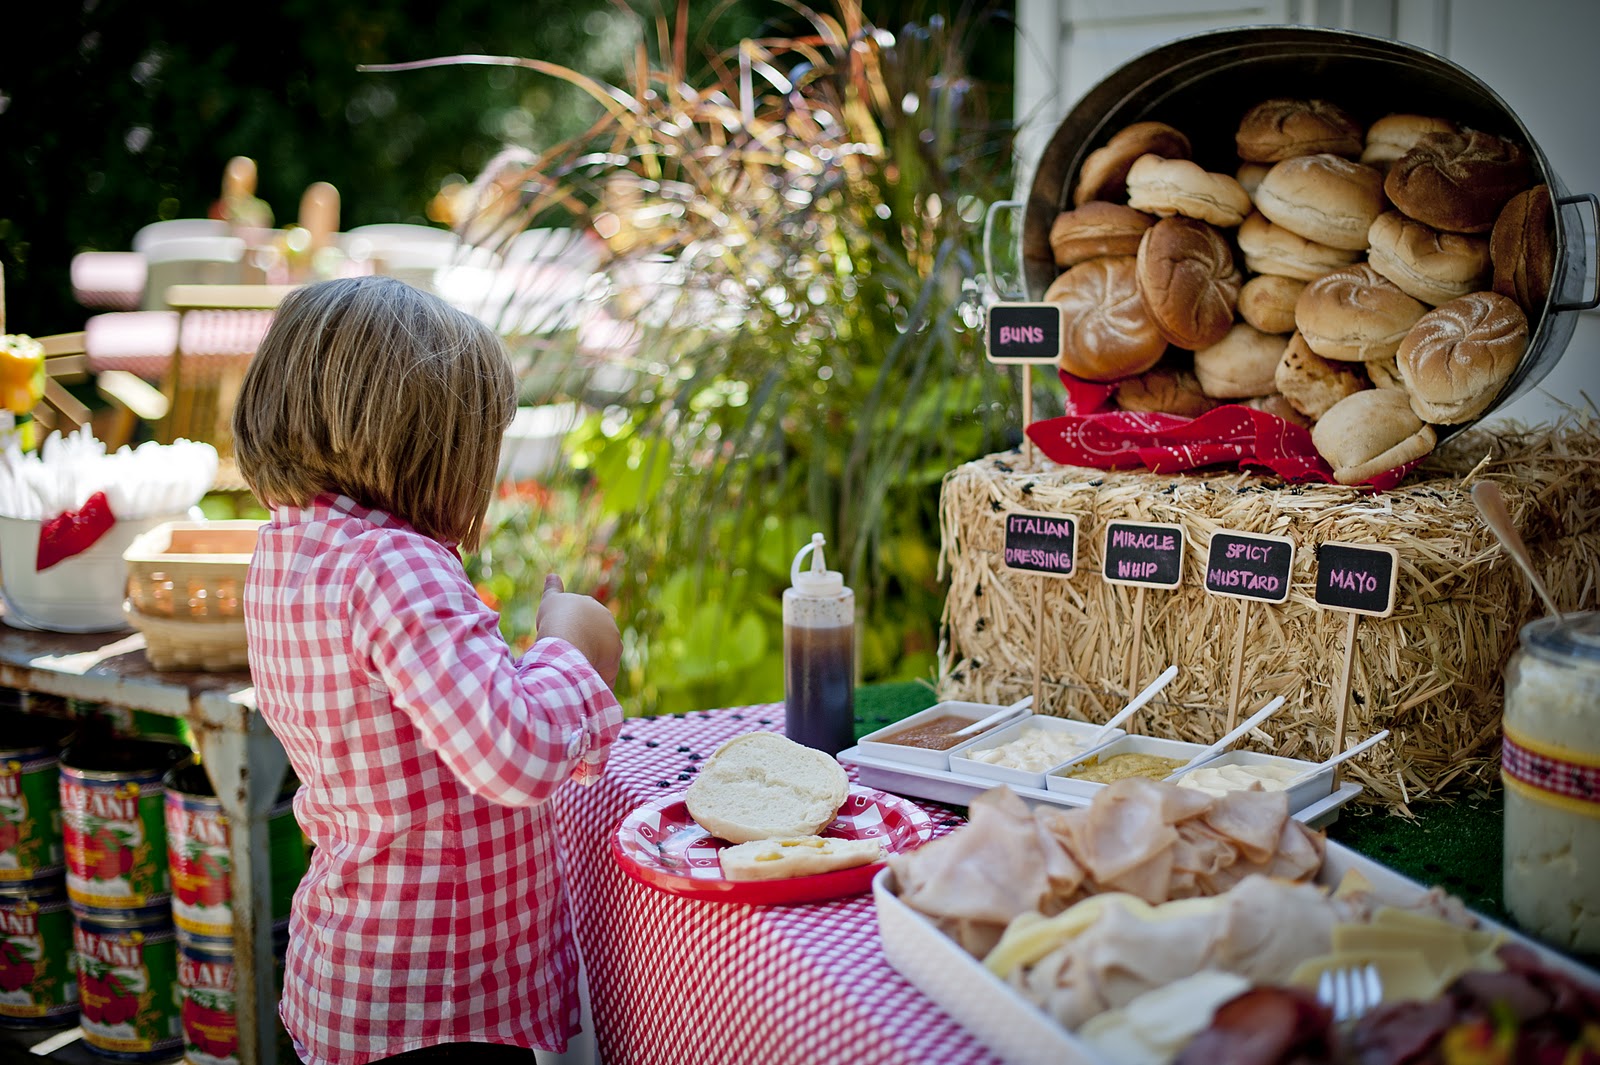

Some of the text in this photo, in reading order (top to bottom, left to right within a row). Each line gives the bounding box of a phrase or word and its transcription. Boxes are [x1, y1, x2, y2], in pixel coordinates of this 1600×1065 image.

[1000, 325, 1044, 344] BUNS
[1010, 517, 1070, 538] ITALIAN
[1113, 530, 1175, 550] MIRACLE
[1005, 548, 1071, 568] DRESSING
[1225, 543, 1272, 563] SPICY
[1118, 560, 1158, 578] WHIP
[1208, 569, 1279, 592] MUSTARD
[1329, 569, 1377, 593] MAYO
